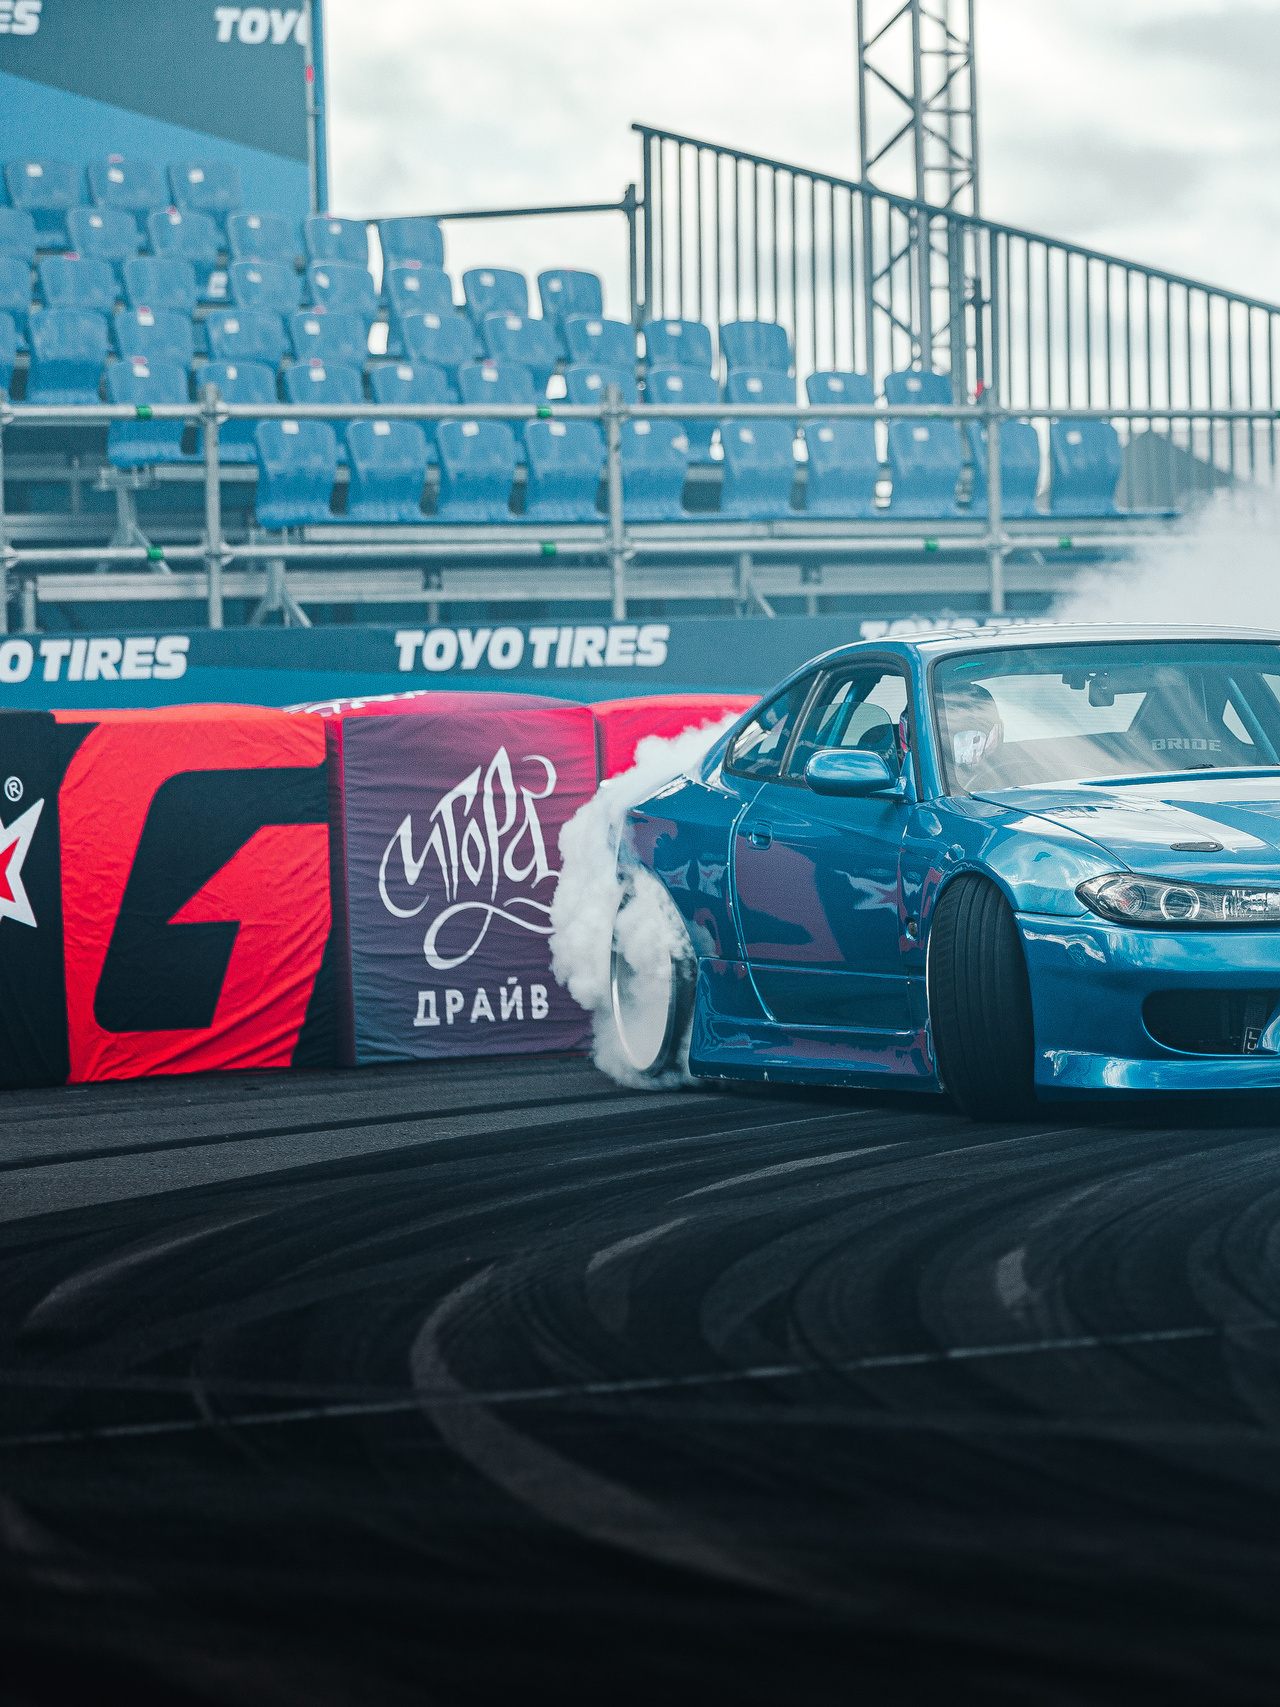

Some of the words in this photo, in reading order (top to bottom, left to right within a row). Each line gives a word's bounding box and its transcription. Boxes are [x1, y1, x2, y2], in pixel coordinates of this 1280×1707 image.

[40, 635, 190, 682] TIRES
[395, 627, 524, 671] TOYO
[529, 624, 670, 668] TIRES
[1151, 738, 1222, 752] BRIDE
[413, 977, 550, 1027] ДРАЙВ
